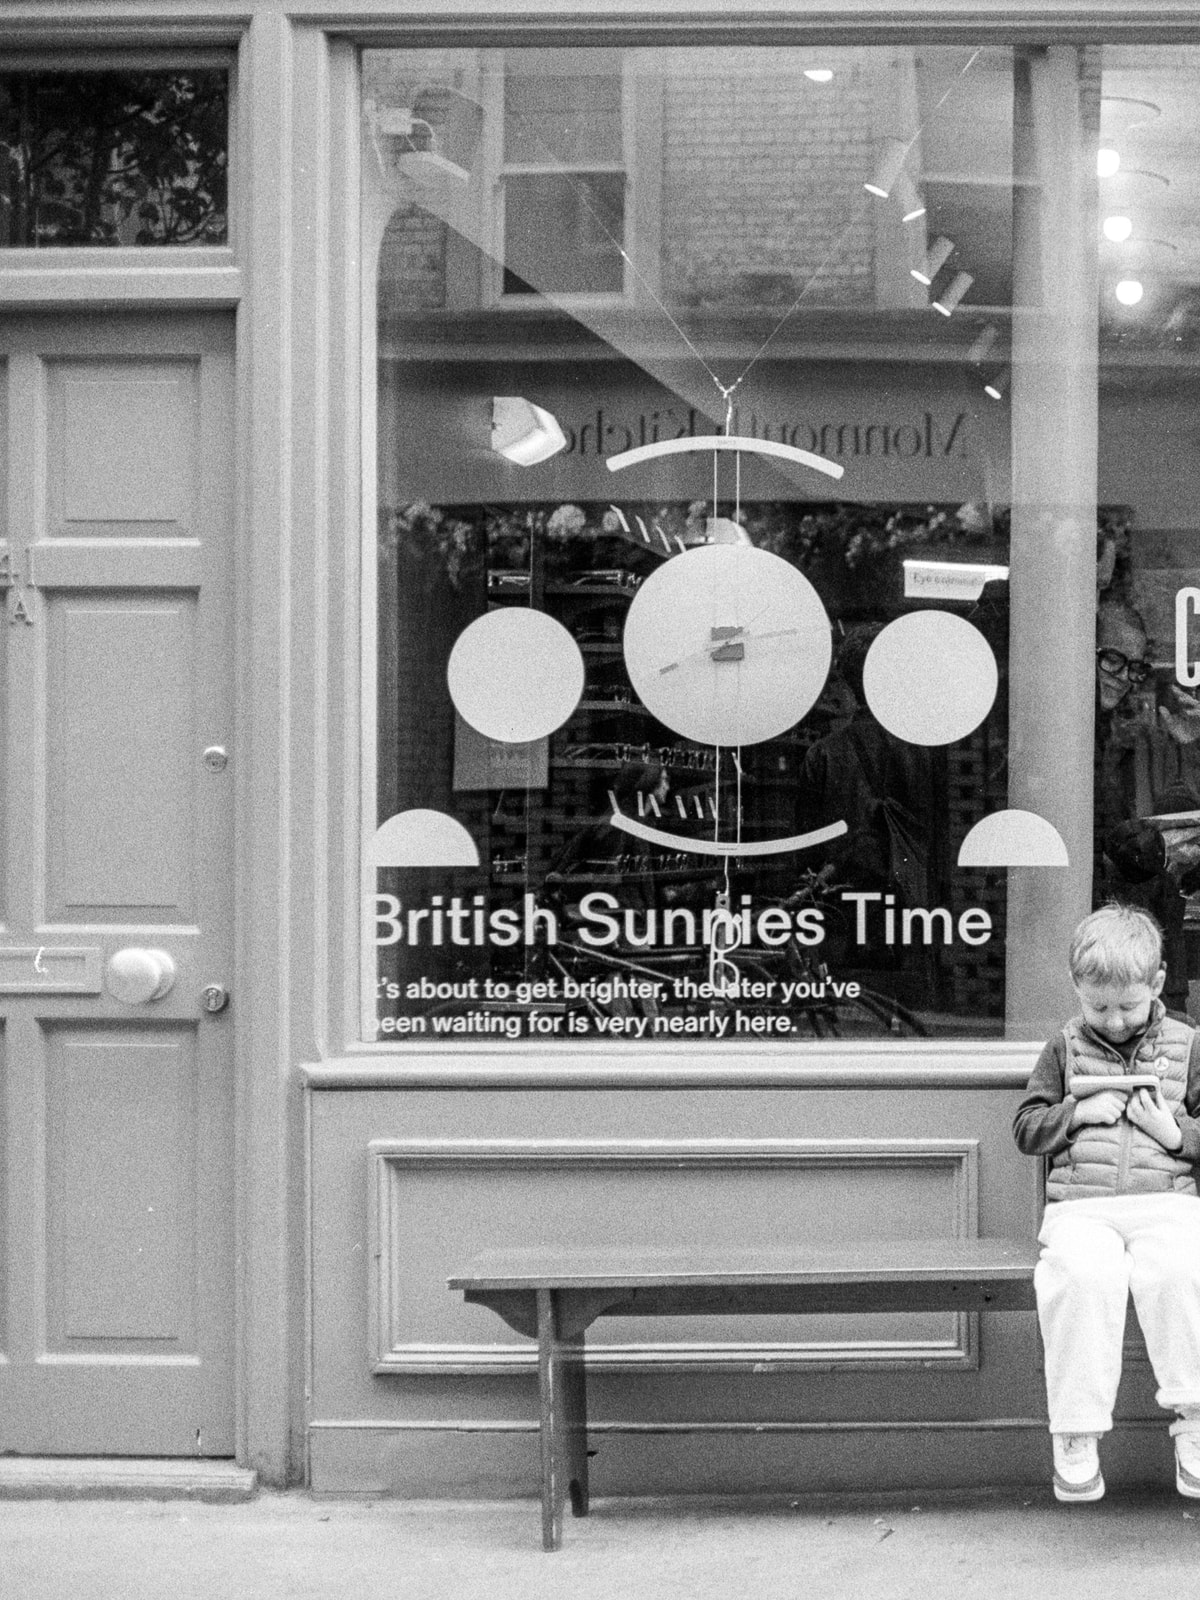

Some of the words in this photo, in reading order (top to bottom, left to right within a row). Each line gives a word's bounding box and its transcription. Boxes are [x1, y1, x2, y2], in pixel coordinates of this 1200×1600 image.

[371, 892, 558, 947] British
[577, 891, 826, 947] Sunnies
[840, 892, 992, 947] Time
[407, 976, 477, 999] about
[485, 979, 510, 999] to
[516, 979, 556, 1004] get
[564, 976, 668, 1004] brighter,
[673, 976, 714, 999] the
[718, 976, 776, 999] later
[781, 975, 861, 1004] you've
[433, 1009, 520, 1038] waiting
[529, 1009, 562, 1033] for
[569, 1009, 588, 1033] is
[596, 1015, 648, 1038] very
[654, 1009, 729, 1038] nearly
[736, 1009, 798, 1033] here.
